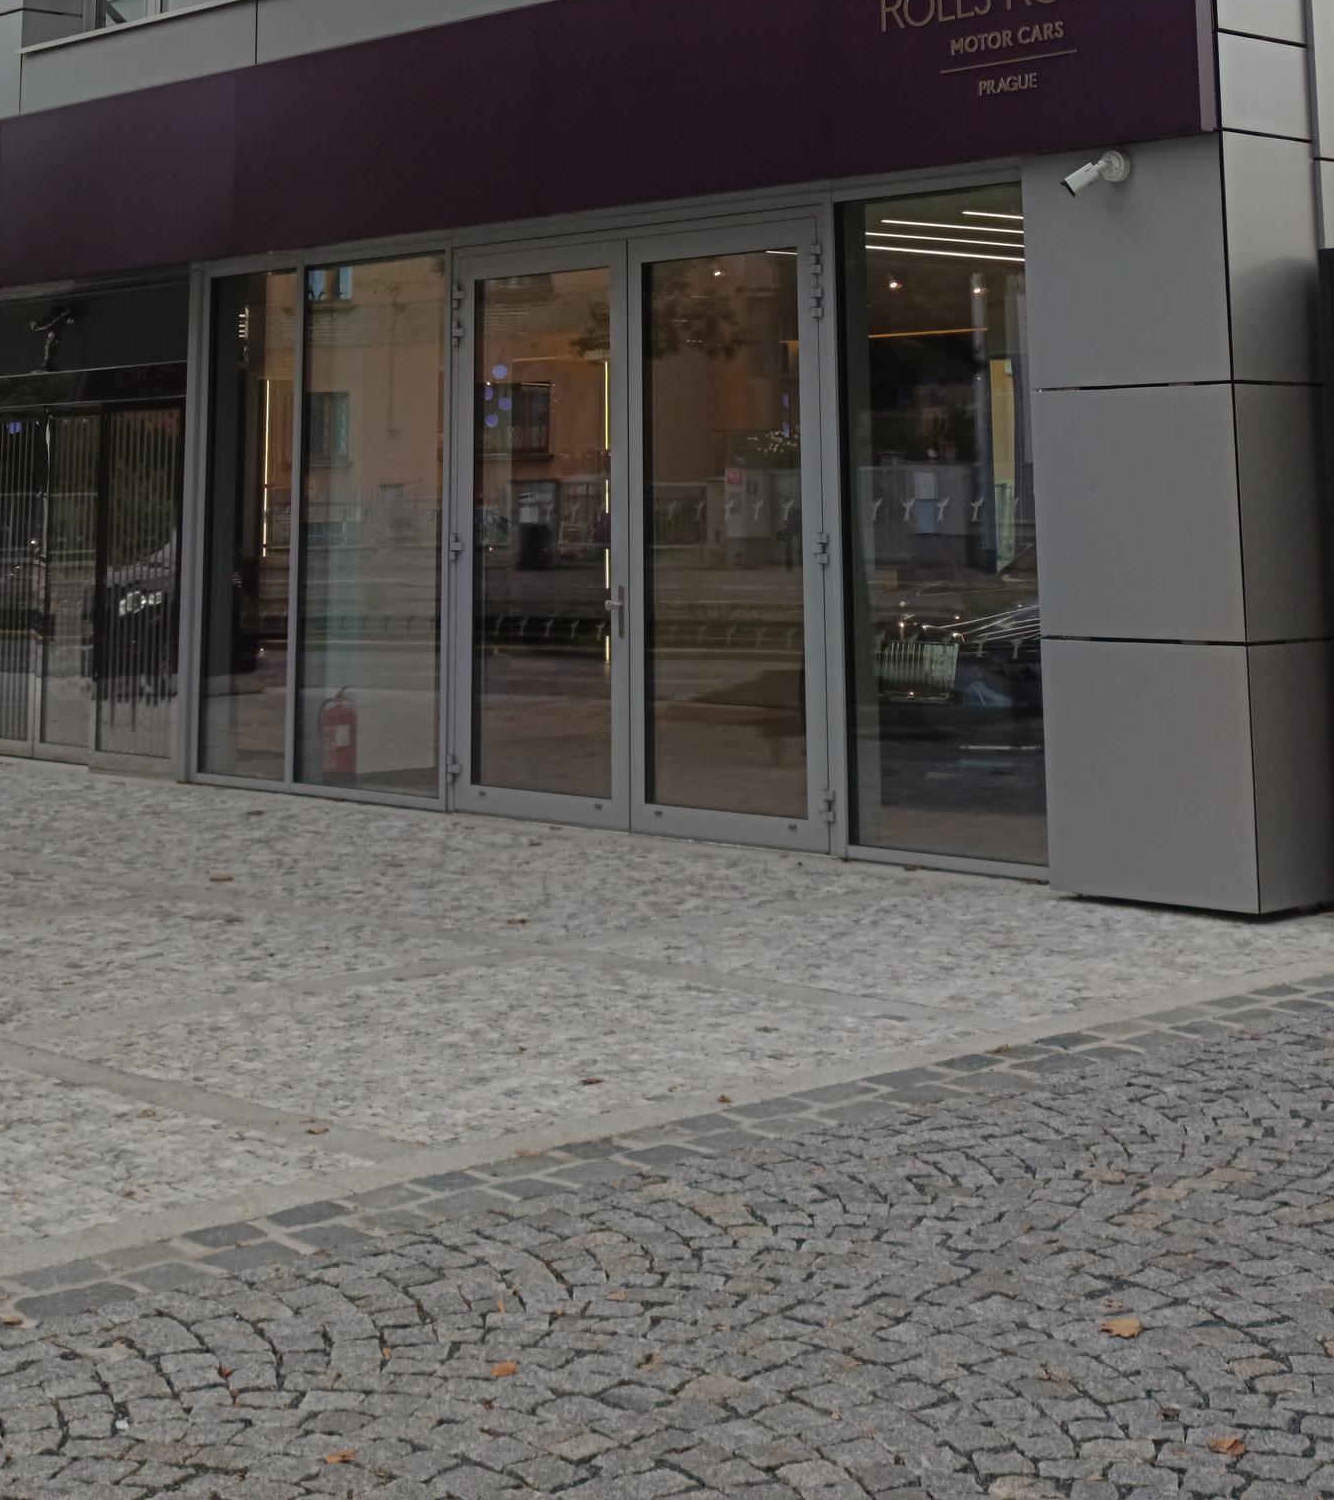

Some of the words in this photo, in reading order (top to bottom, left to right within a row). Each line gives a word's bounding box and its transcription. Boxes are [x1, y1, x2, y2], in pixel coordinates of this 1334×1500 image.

[950, 28, 1013, 56] MOTOR
[1017, 21, 1065, 45] CARS
[977, 72, 1038, 97] PRAGUE
